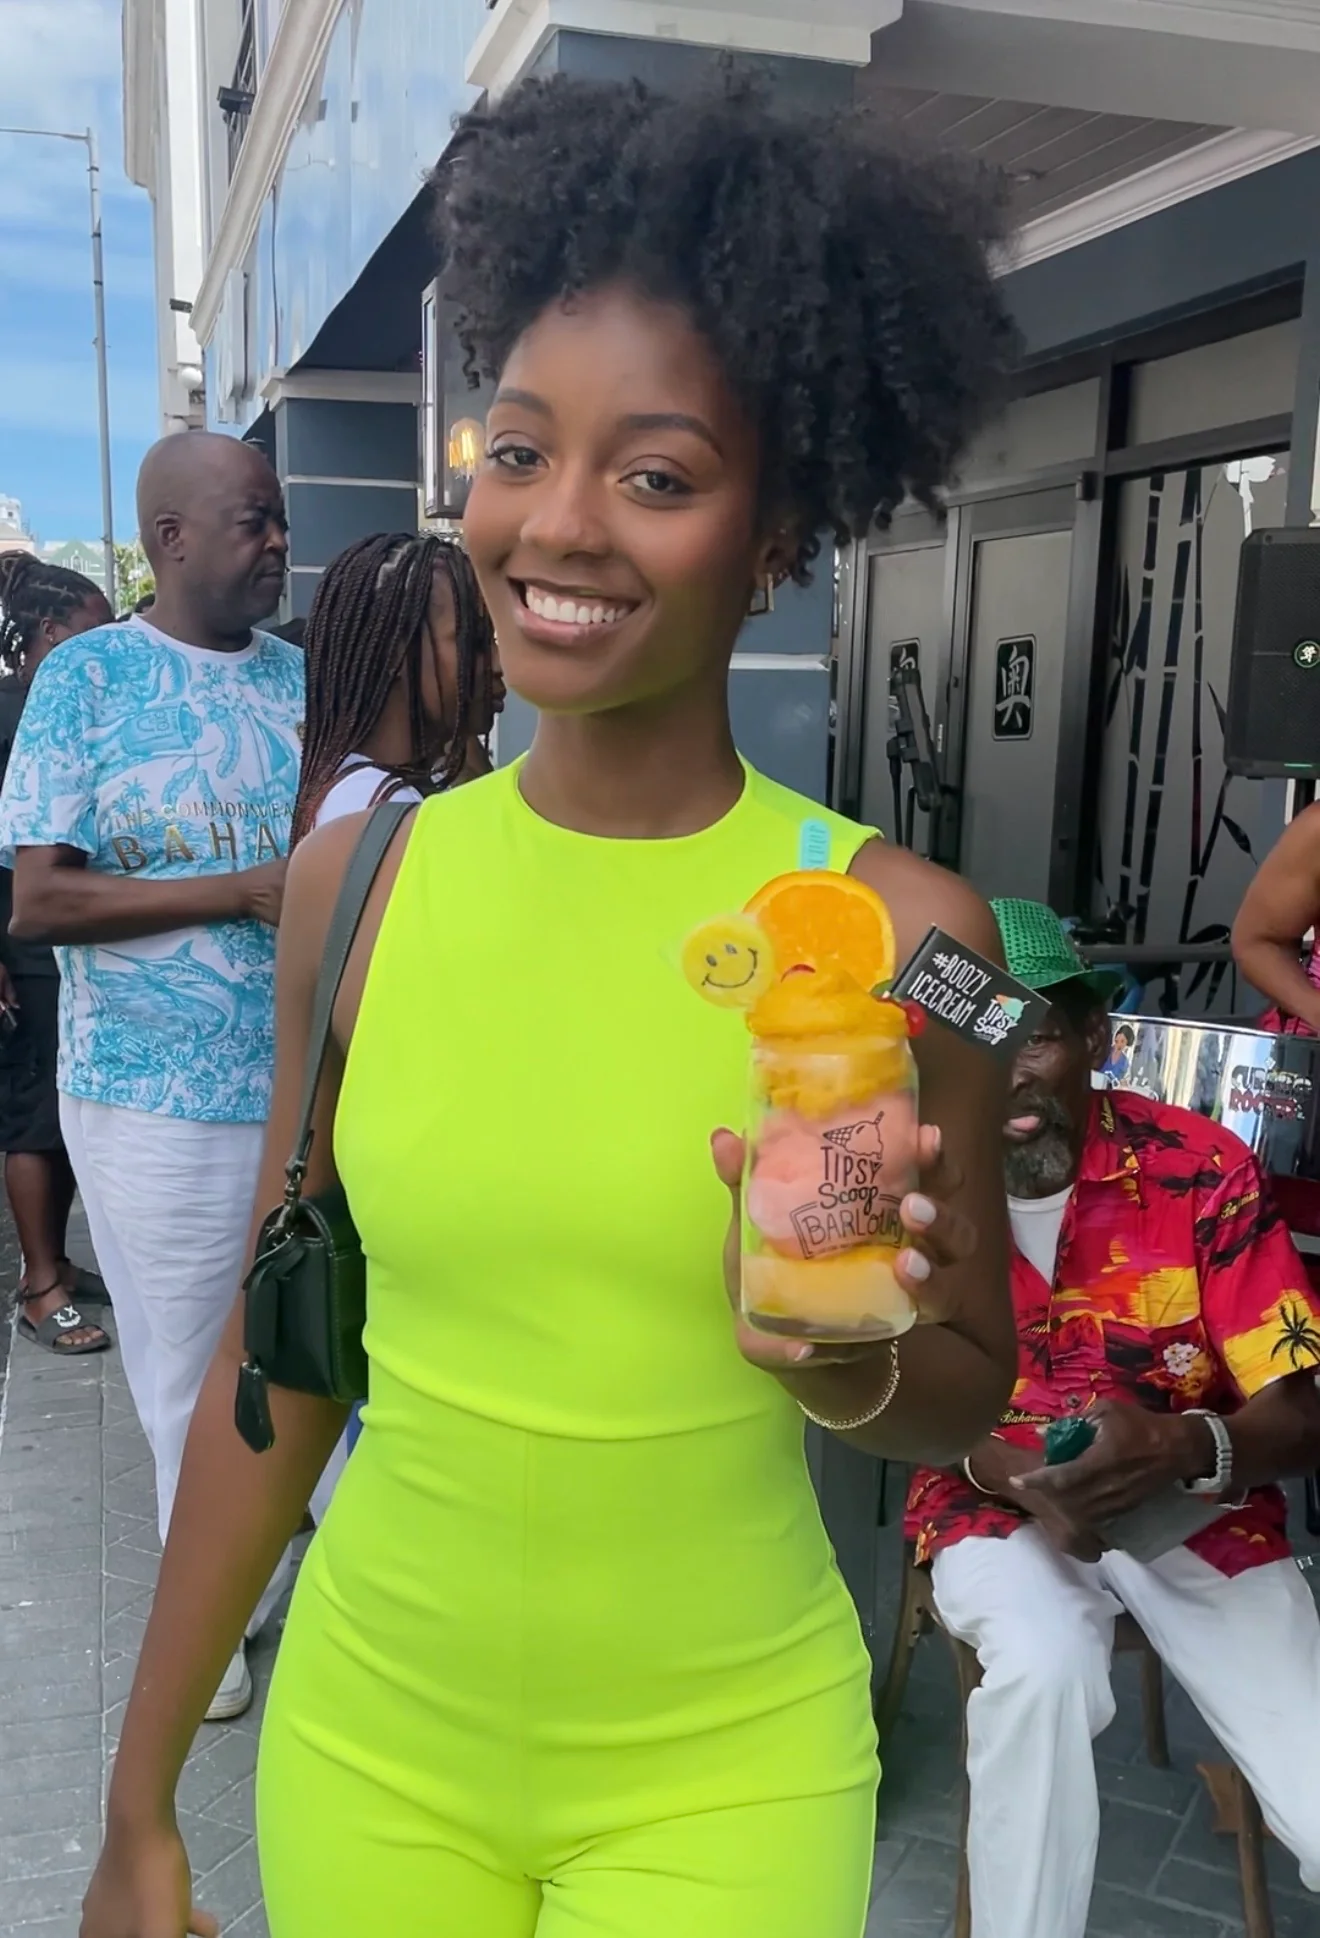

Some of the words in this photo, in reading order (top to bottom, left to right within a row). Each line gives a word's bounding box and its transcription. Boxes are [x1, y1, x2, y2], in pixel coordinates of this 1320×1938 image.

[931, 951, 993, 998] #BOOZY
[906, 970, 978, 1028] ICECREAM
[983, 998, 1019, 1031] TIPSY
[973, 1016, 1009, 1046] Scoop
[820, 1145, 884, 1187] TIPSY
[818, 1182, 879, 1216] Scoop
